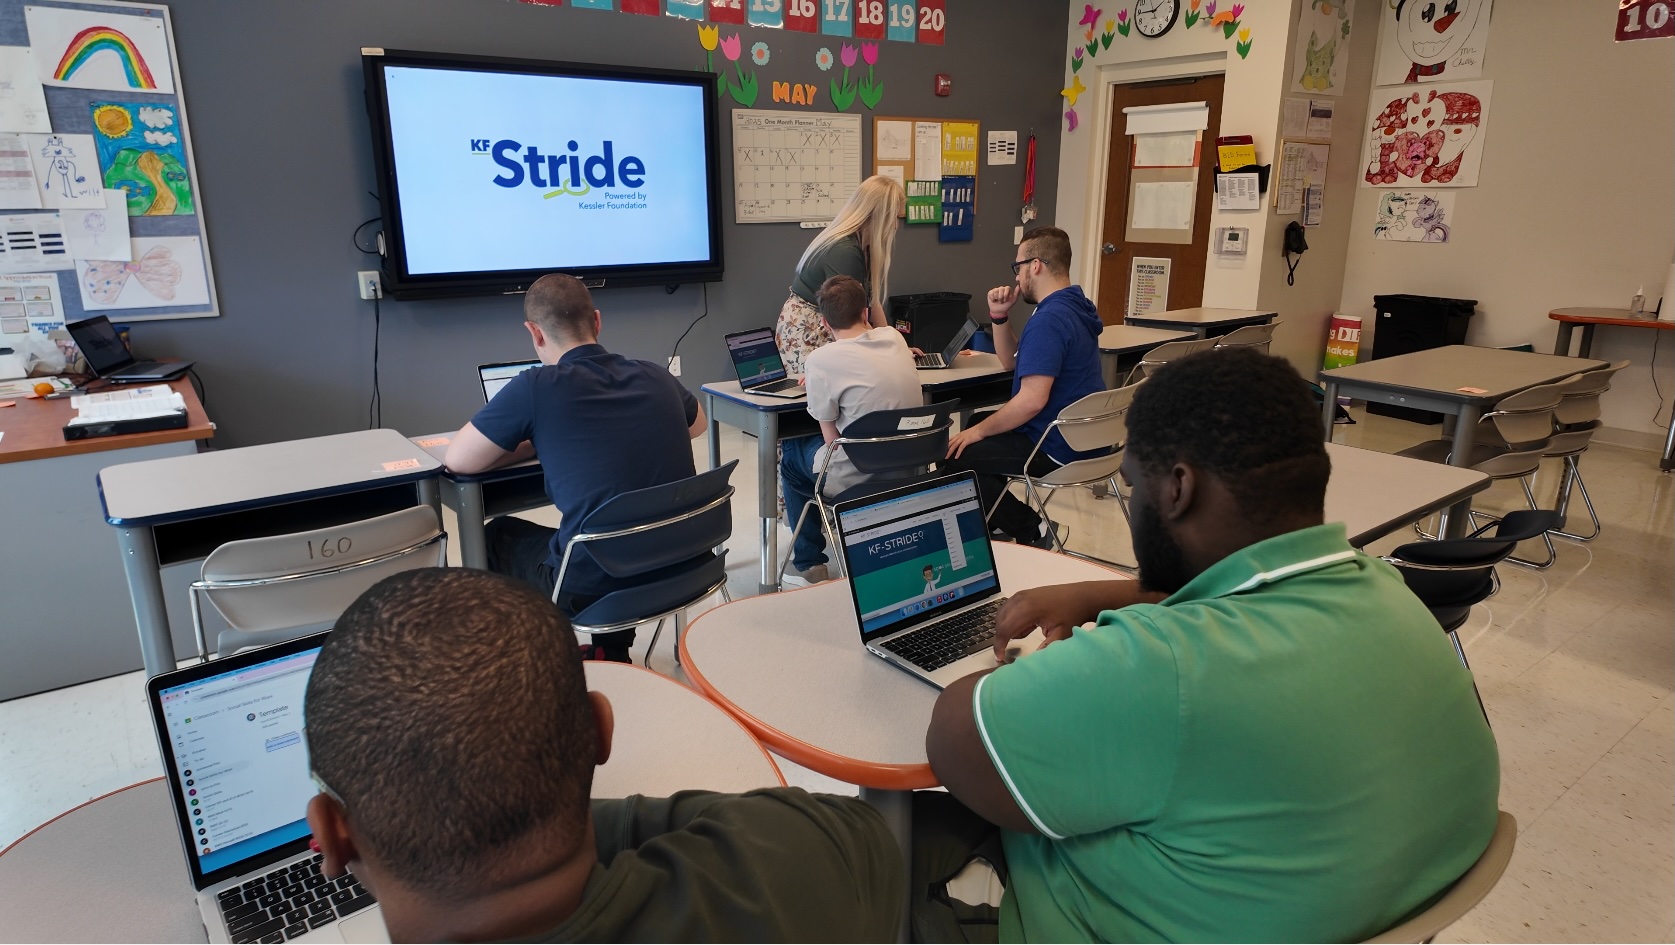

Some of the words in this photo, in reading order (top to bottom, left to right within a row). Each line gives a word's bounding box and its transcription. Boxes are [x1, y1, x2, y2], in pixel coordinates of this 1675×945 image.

[789, 0, 815, 17] 16
[825, 0, 848, 21] 17
[858, 1, 884, 24] 18
[889, 4, 915, 28] 19
[919, 7, 945, 32] 20
[1623, 2, 1670, 32] 10
[772, 81, 817, 105] MAY
[815, 118, 832, 129] May
[470, 139, 490, 152] KF
[492, 139, 646, 188] Stride
[578, 202, 605, 210] Kessler
[607, 202, 647, 210] Foundation
[638, 192, 647, 202] by
[307, 536, 352, 560] 160
[868, 532, 919, 556] KF-STRIDE
[258, 705, 289, 718] Template
